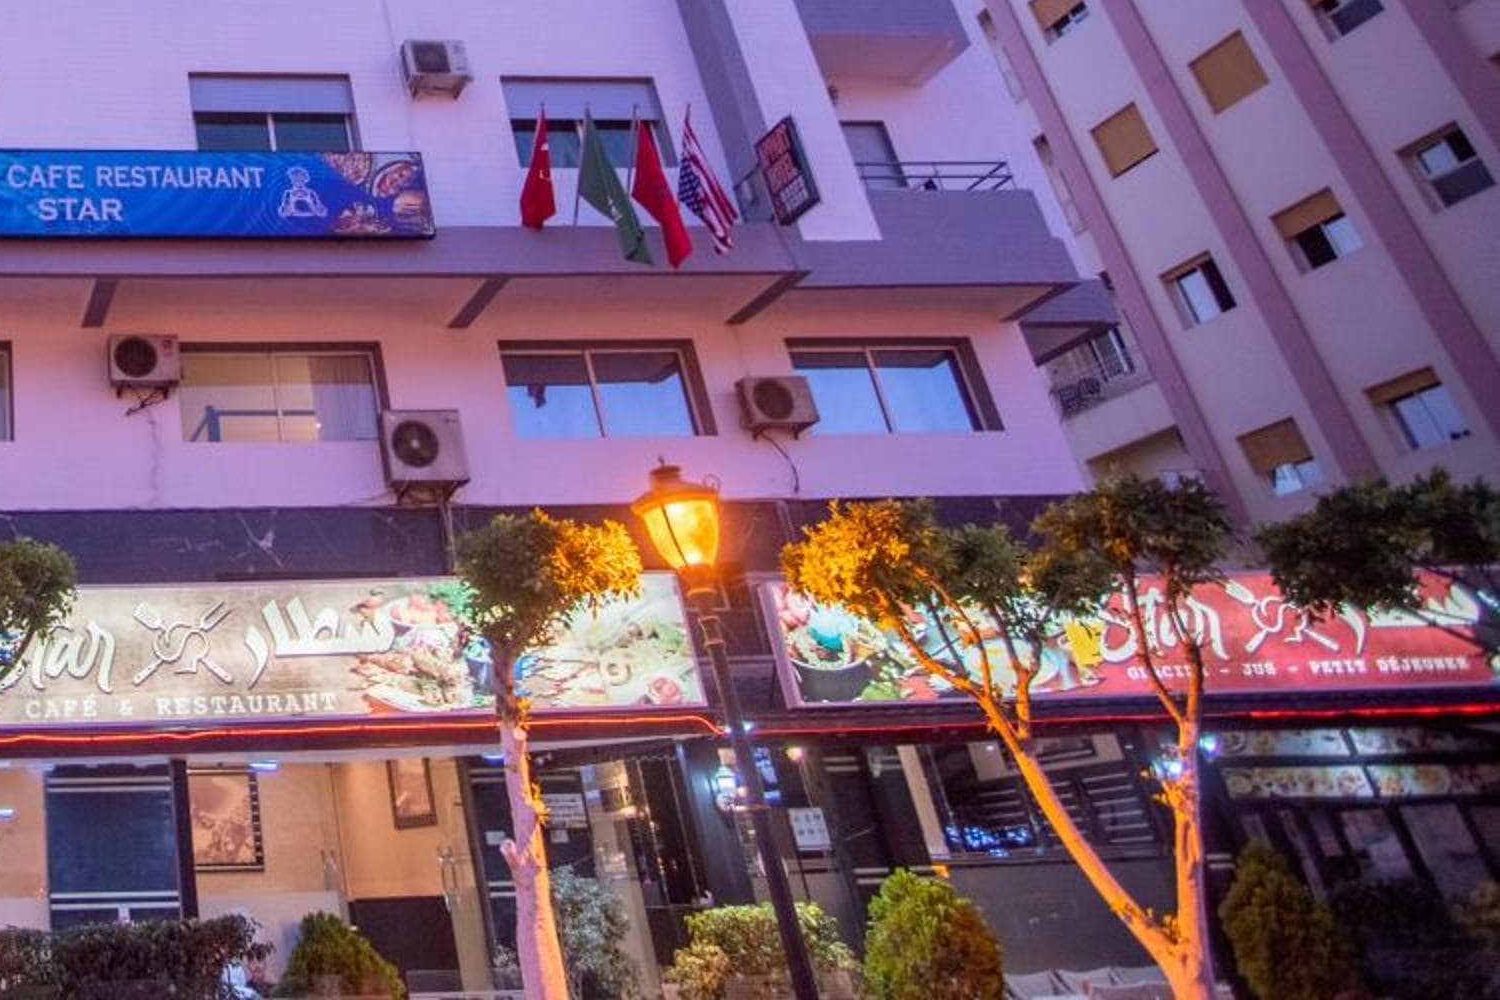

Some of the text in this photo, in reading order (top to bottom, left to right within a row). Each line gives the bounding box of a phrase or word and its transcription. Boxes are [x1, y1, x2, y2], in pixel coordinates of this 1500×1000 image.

[7, 164, 85, 188] CAFE
[96, 165, 265, 188] RESTAURANT
[38, 198, 124, 221] STAR
[1309, 659, 1368, 674] PETIT
[156, 693, 338, 716] RESTAURANT
